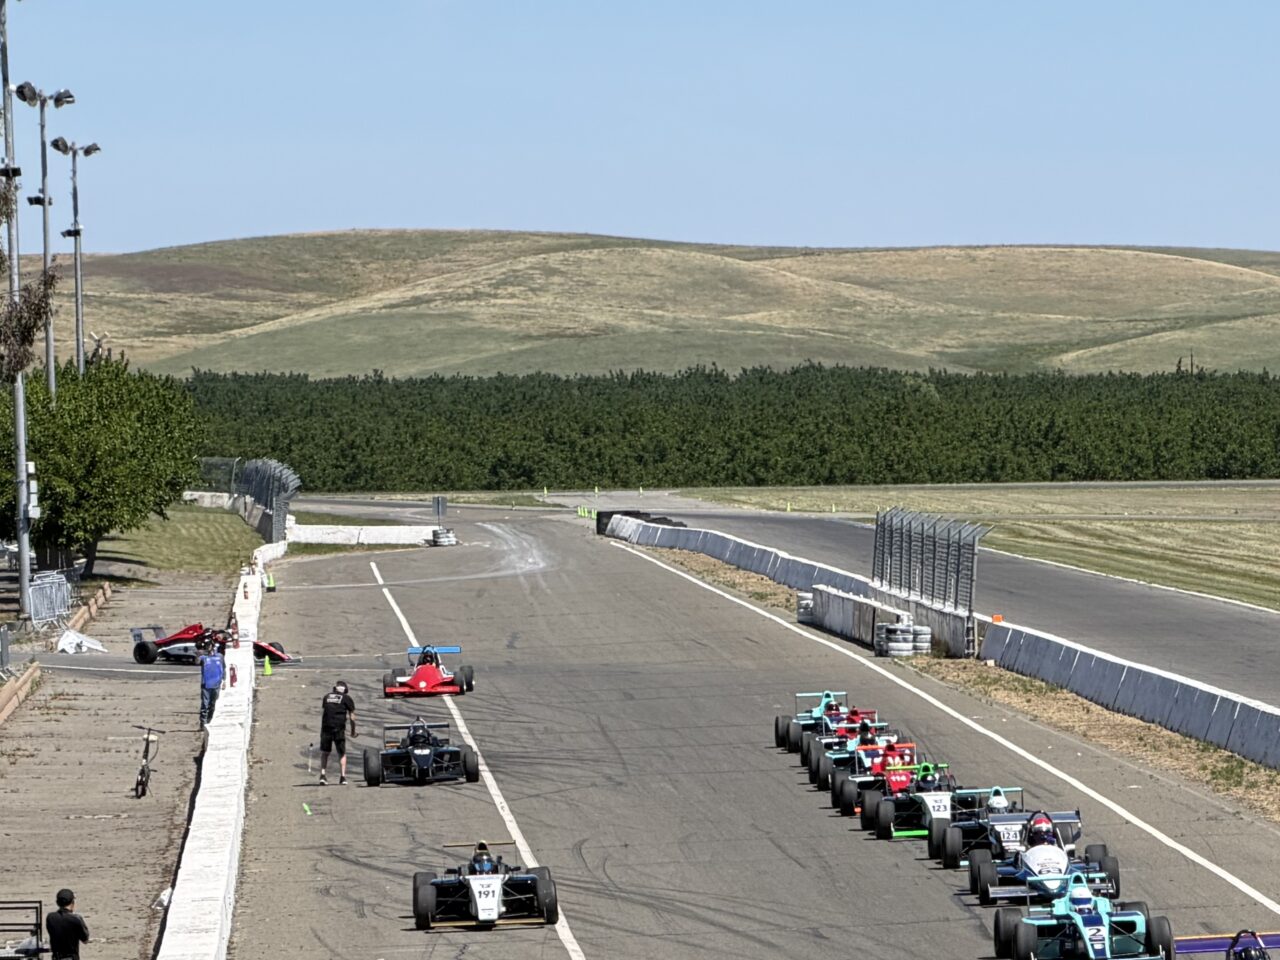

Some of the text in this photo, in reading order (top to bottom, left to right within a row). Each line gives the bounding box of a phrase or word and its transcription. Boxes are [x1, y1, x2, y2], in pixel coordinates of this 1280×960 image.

[932, 804, 948, 812] 123
[1002, 832, 1018, 840] 124
[478, 890, 496, 898] 191
[1088, 927, 1104, 937] 2
